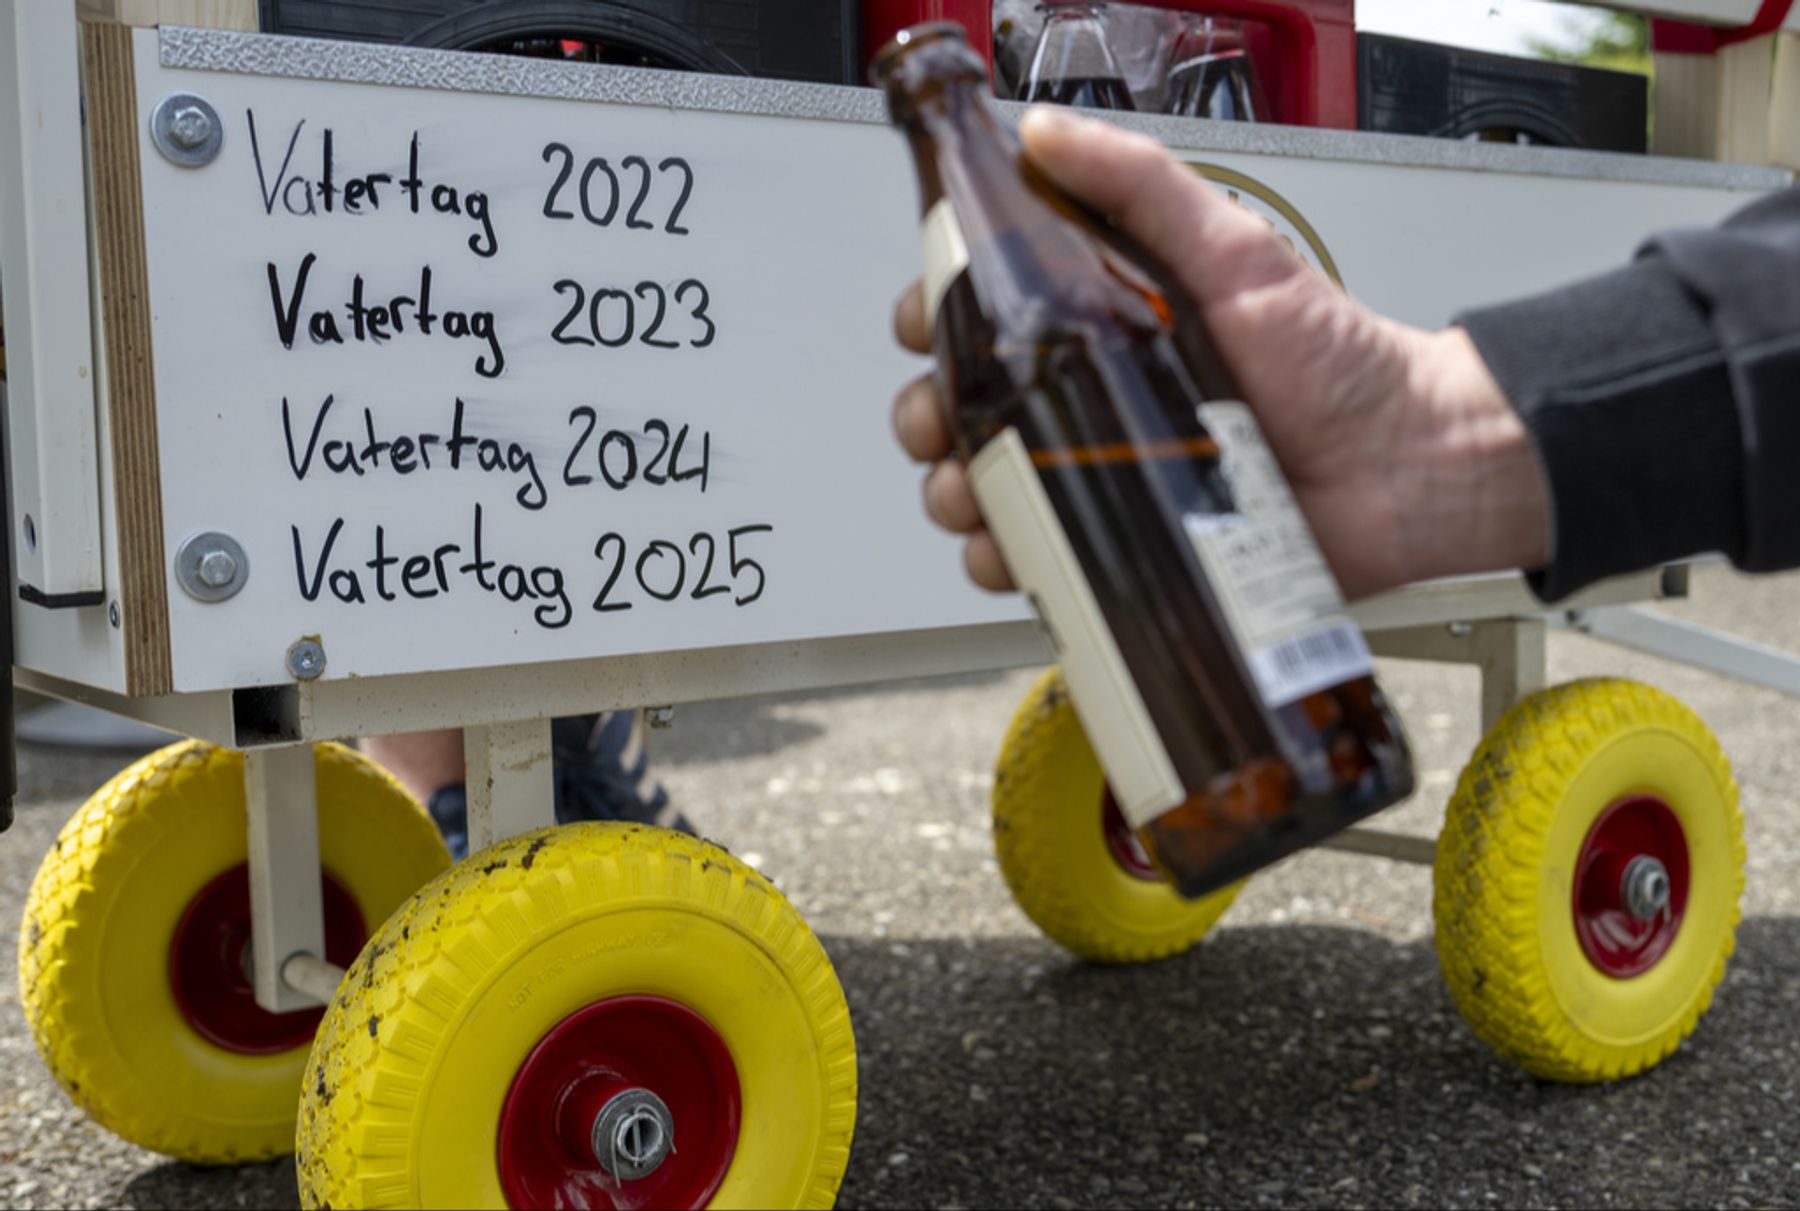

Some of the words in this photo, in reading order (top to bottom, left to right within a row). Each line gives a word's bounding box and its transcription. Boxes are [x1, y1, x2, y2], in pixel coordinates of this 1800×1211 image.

[246, 108, 500, 258] Vatertag
[541, 142, 695, 236] 2022
[267, 252, 506, 379] Vatertag
[550, 278, 717, 349] 2023
[282, 393, 549, 511] Vatertag
[562, 405, 711, 493] 2024
[291, 501, 574, 629] Vatertag
[592, 524, 774, 613] 2025
